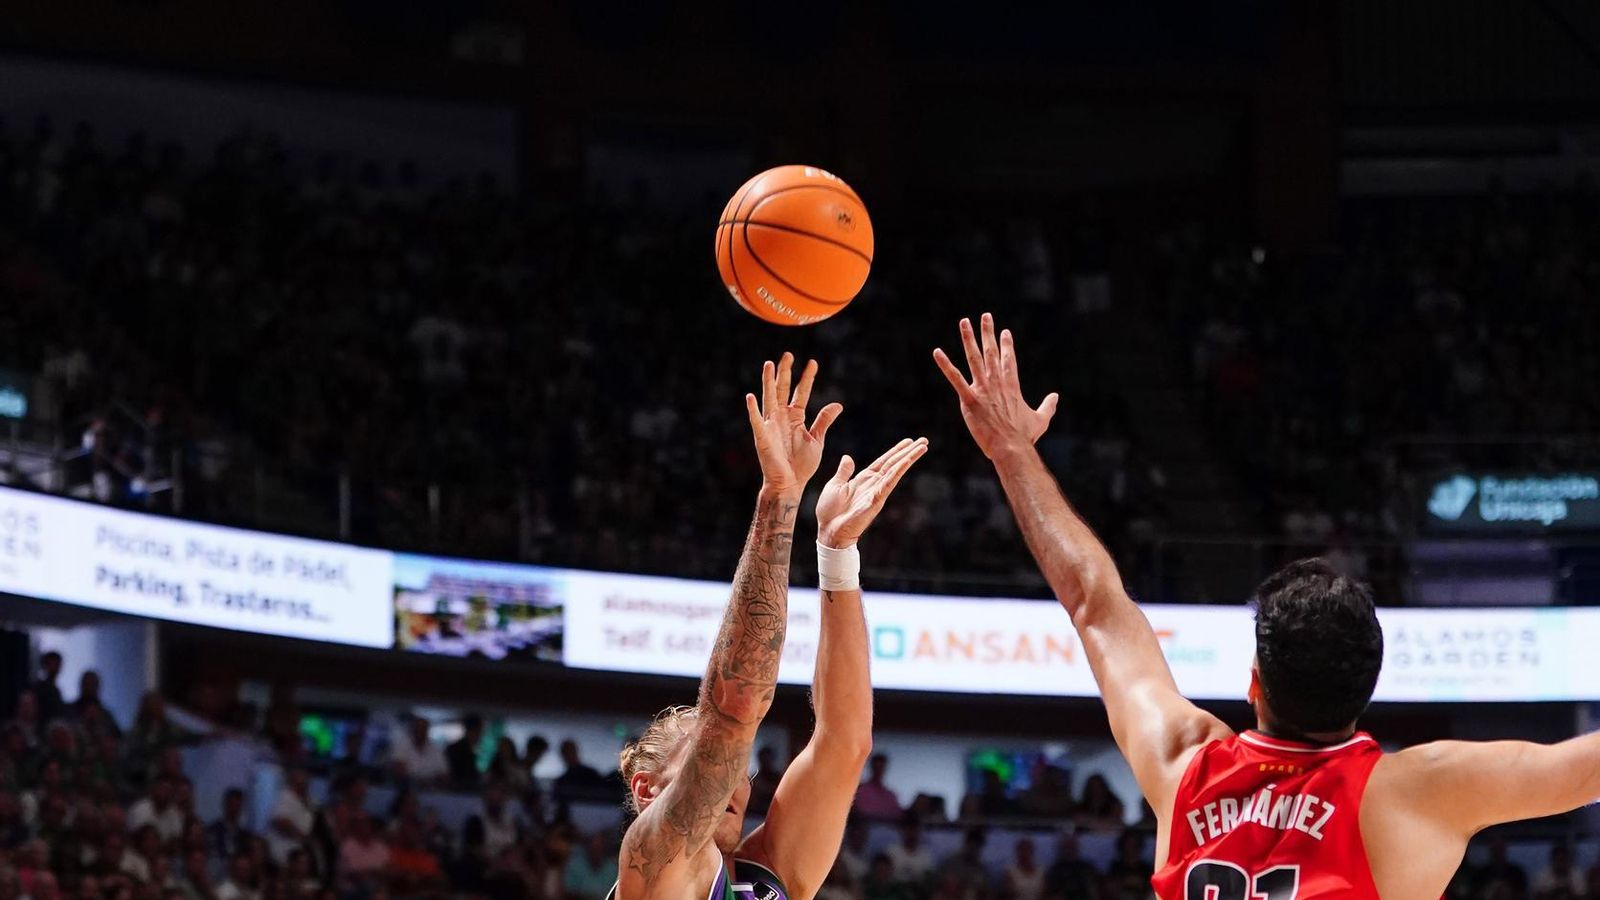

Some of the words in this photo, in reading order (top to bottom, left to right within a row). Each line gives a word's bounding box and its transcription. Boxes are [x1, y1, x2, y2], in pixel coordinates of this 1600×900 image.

[186, 538, 240, 568] Pista
[248, 551, 276, 577] de
[96, 565, 189, 606] Parking,
[1392, 651, 1540, 669] GARDEN
